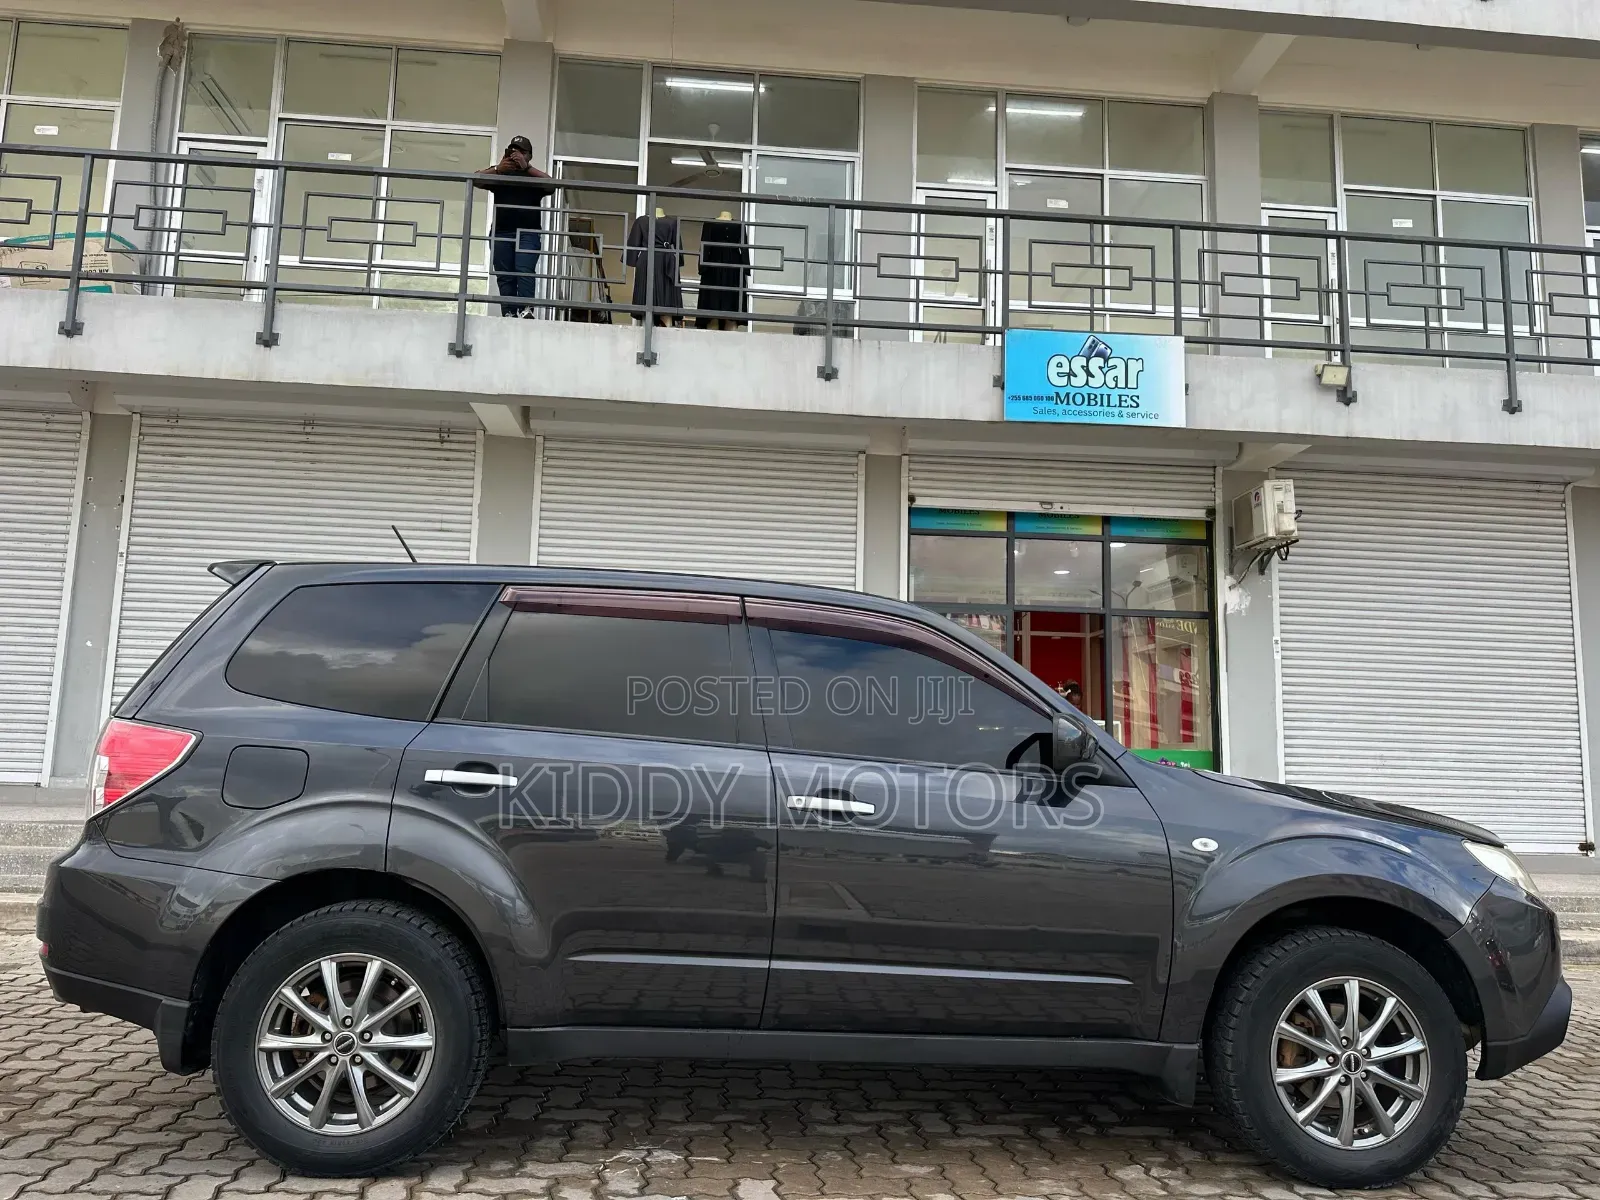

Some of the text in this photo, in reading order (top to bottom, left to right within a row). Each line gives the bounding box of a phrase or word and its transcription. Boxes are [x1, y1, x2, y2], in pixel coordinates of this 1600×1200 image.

[1047, 353, 1144, 389] essar
[1054, 391, 1140, 408] MOBILES
[1032, 406, 1160, 420] Sales, accessories & service
